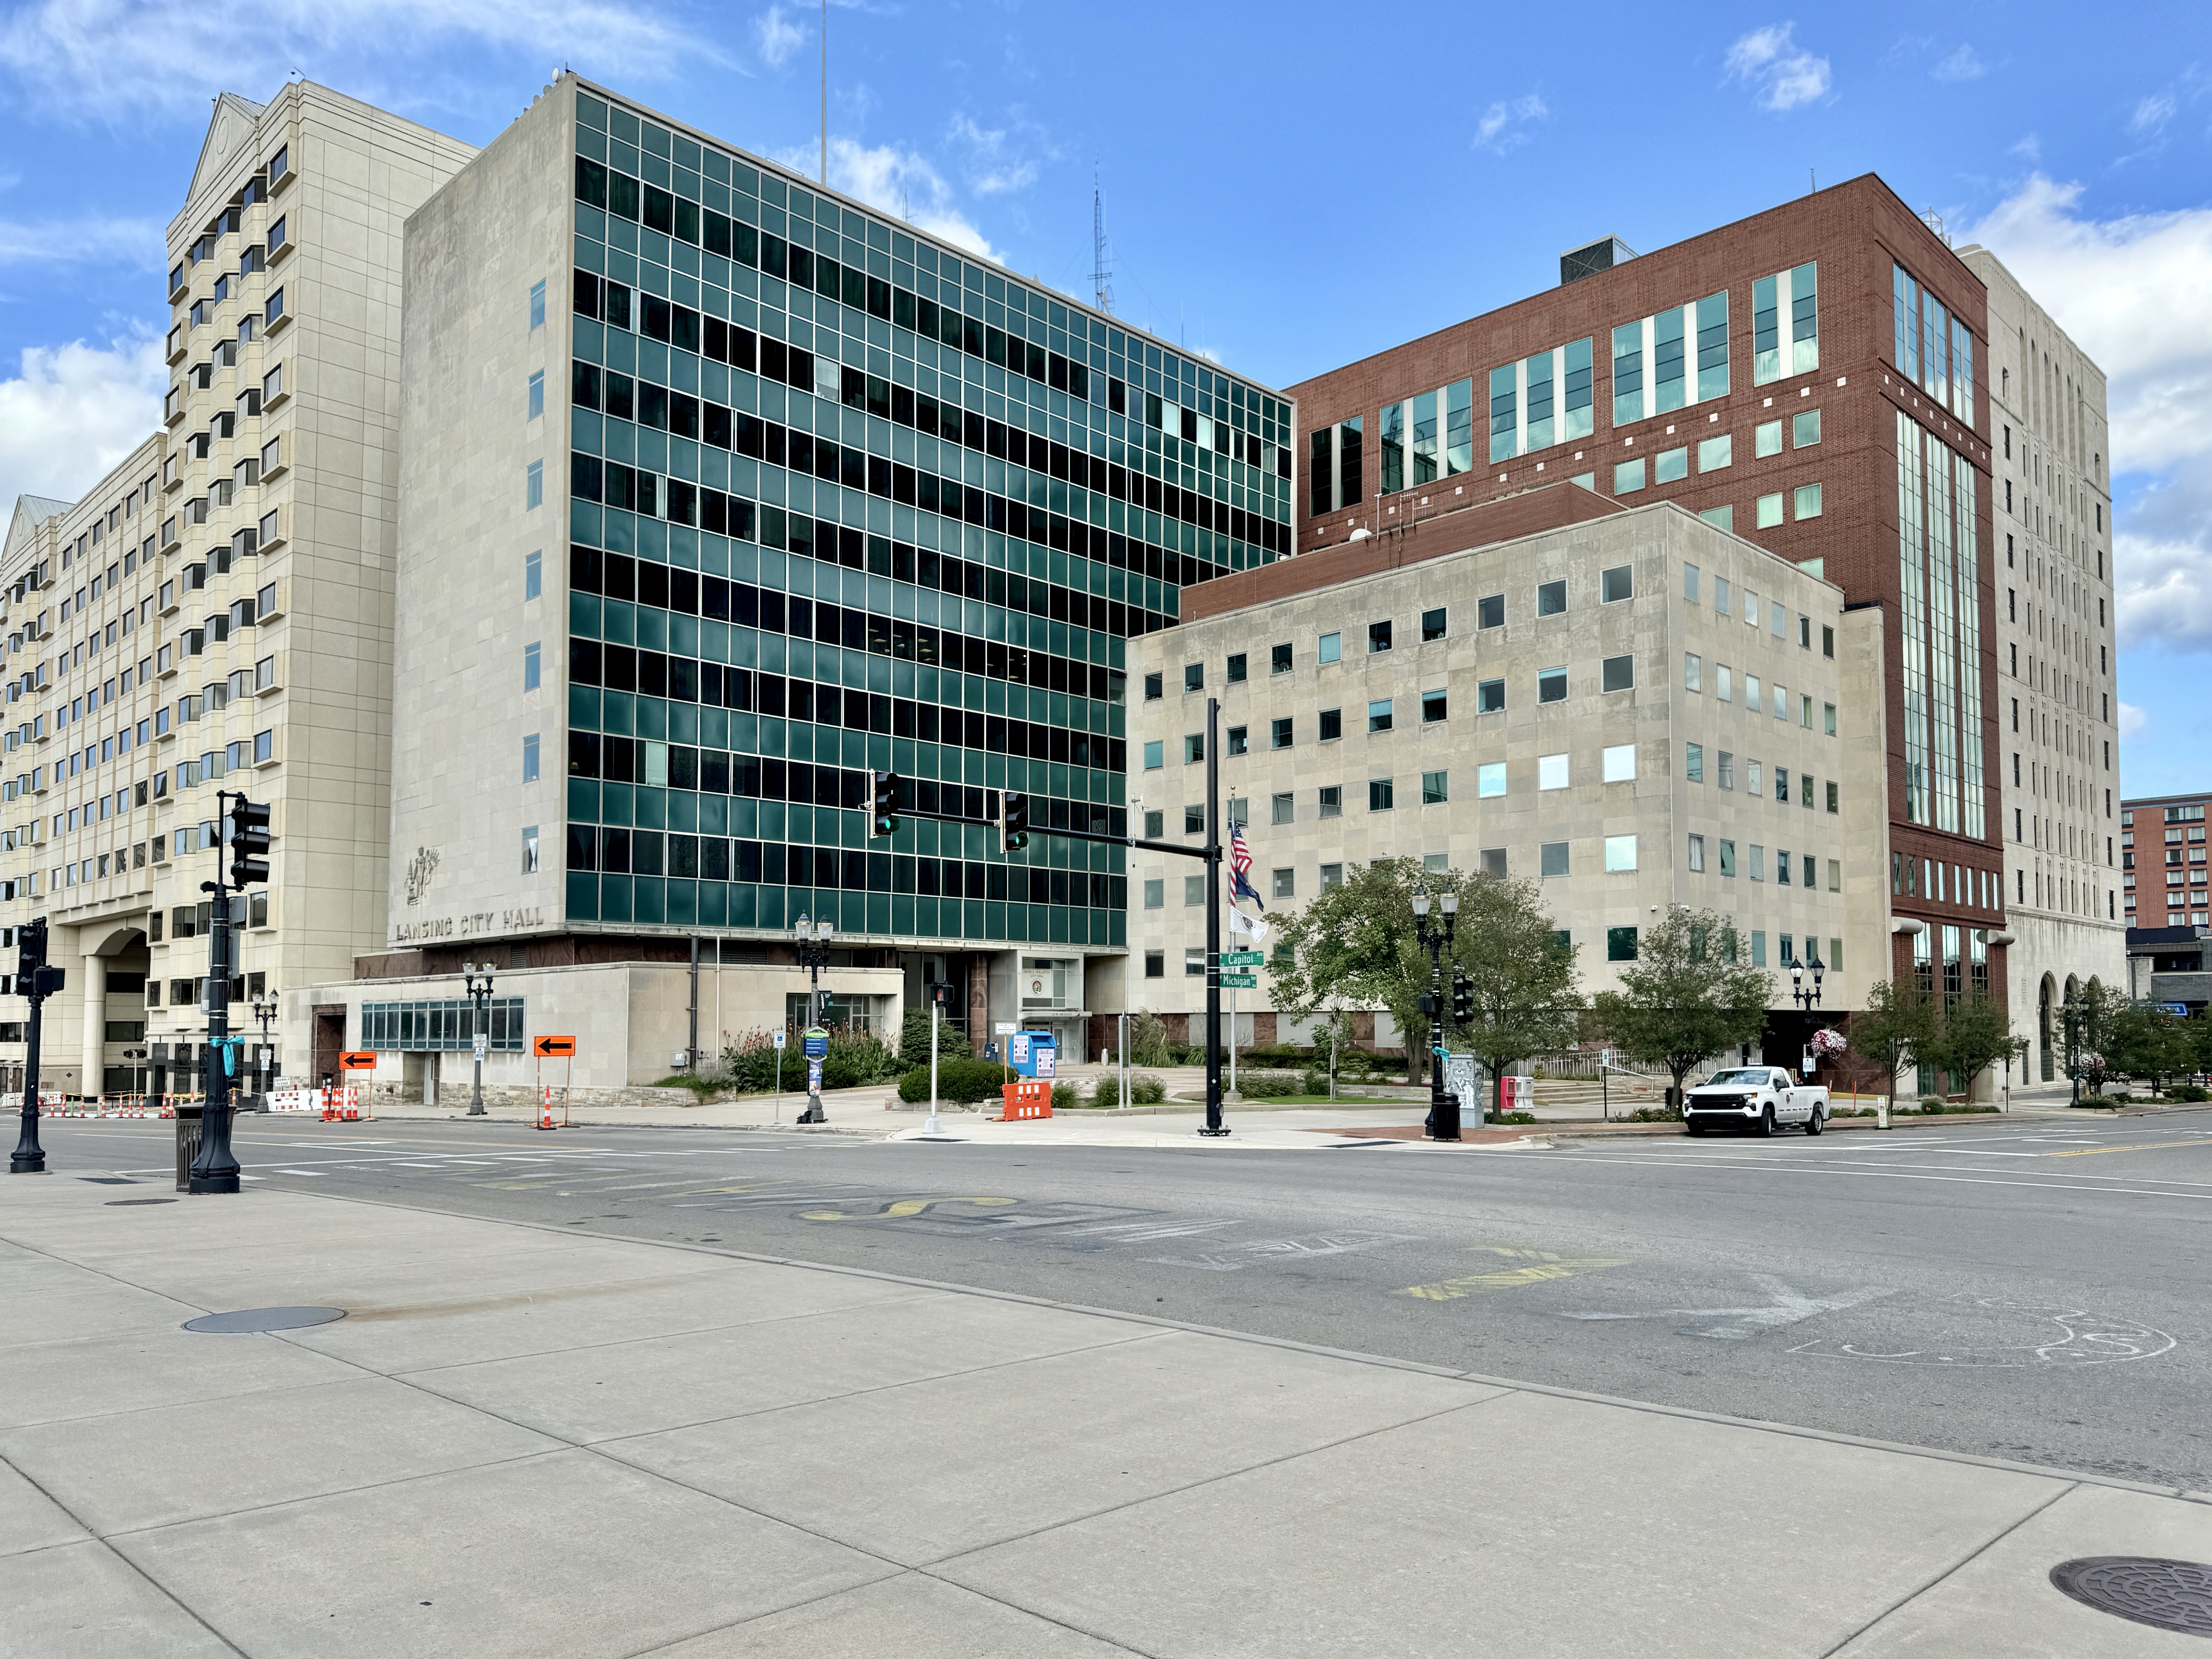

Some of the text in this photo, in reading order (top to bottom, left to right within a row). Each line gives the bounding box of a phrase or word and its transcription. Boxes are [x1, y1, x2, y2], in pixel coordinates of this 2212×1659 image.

[396, 906, 544, 941] LANSING CITY HALL
[1228, 953, 1253, 966] Capitol
[1223, 974, 1250, 987] Michigan
